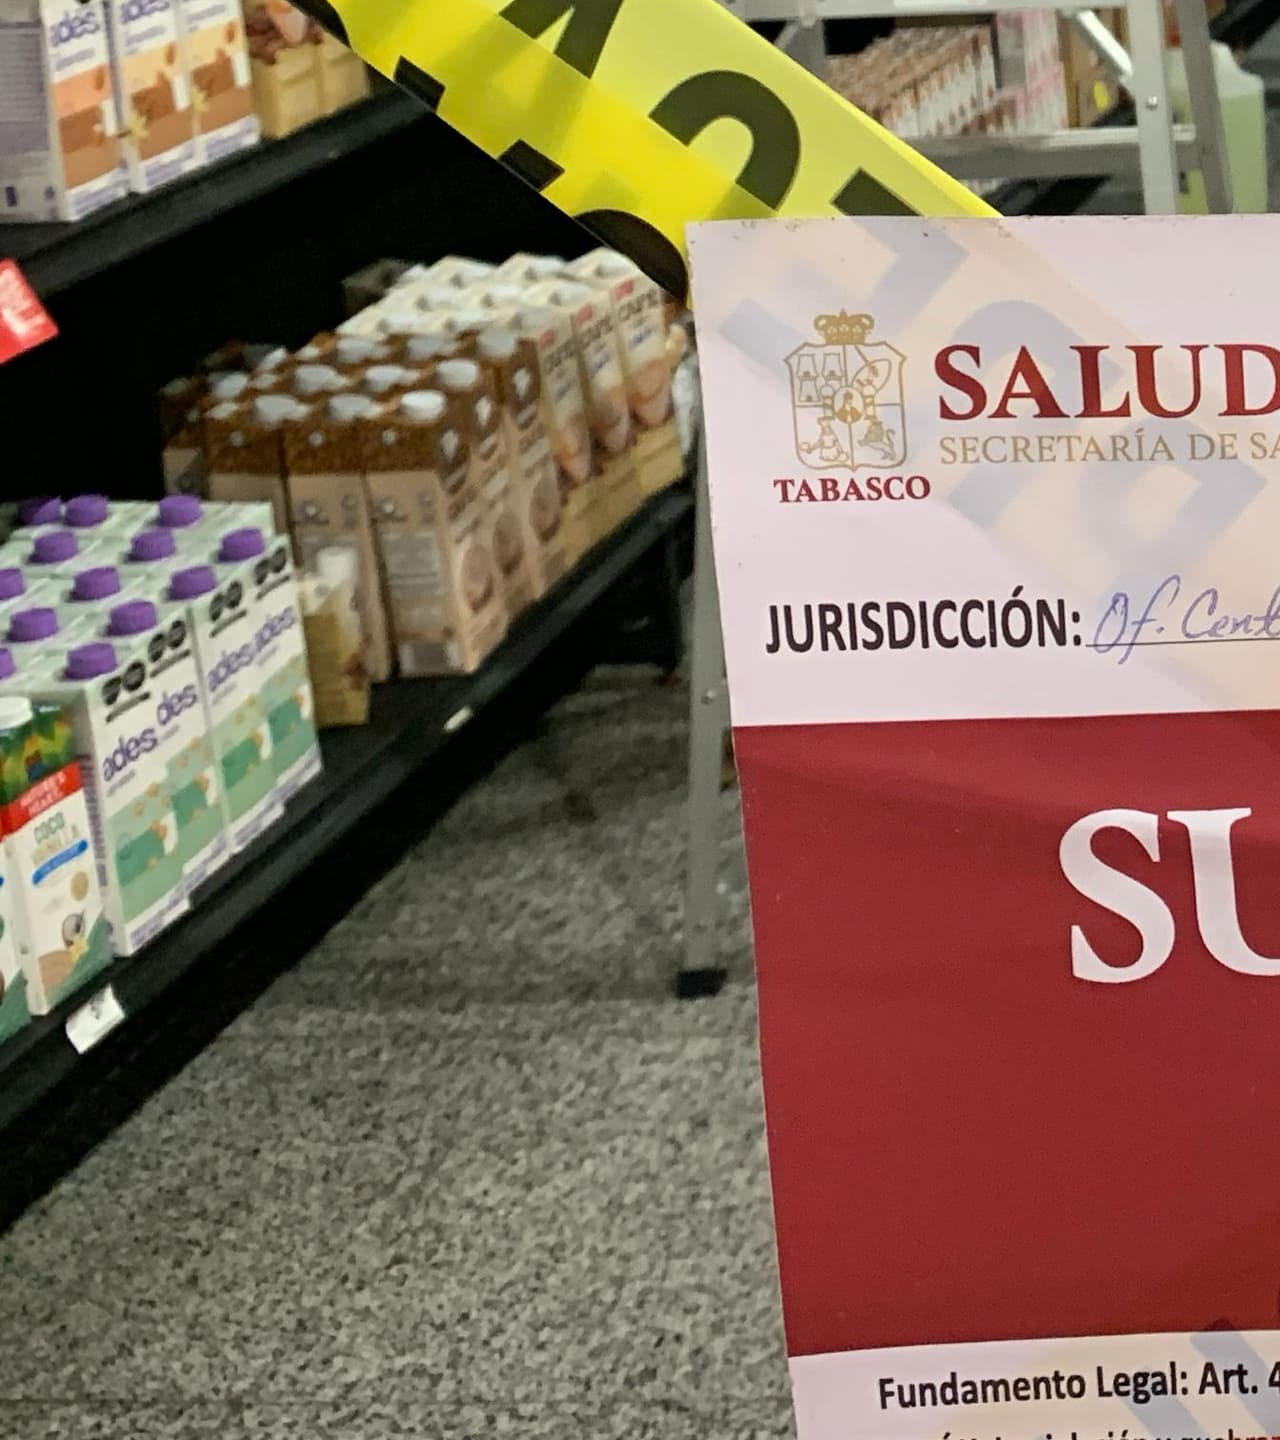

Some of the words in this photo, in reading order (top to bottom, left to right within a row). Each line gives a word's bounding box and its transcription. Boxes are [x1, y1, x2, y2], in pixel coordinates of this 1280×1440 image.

[50, 11, 99, 48] ades
[940, 427, 1178, 465] SECRETARÍA
[1189, 432, 1237, 461] DE
[773, 475, 932, 503] TABASCO
[254, 606, 296, 652] ades
[766, 585, 1082, 654] JURISDICCIÓN:
[207, 641, 254, 693] ades
[156, 684, 199, 727] des
[102, 728, 159, 783] ades
[879, 1367, 1085, 1410] Fundamento
[1097, 1362, 1187, 1405] Legal:
[1198, 1364, 1258, 1396] Art.
